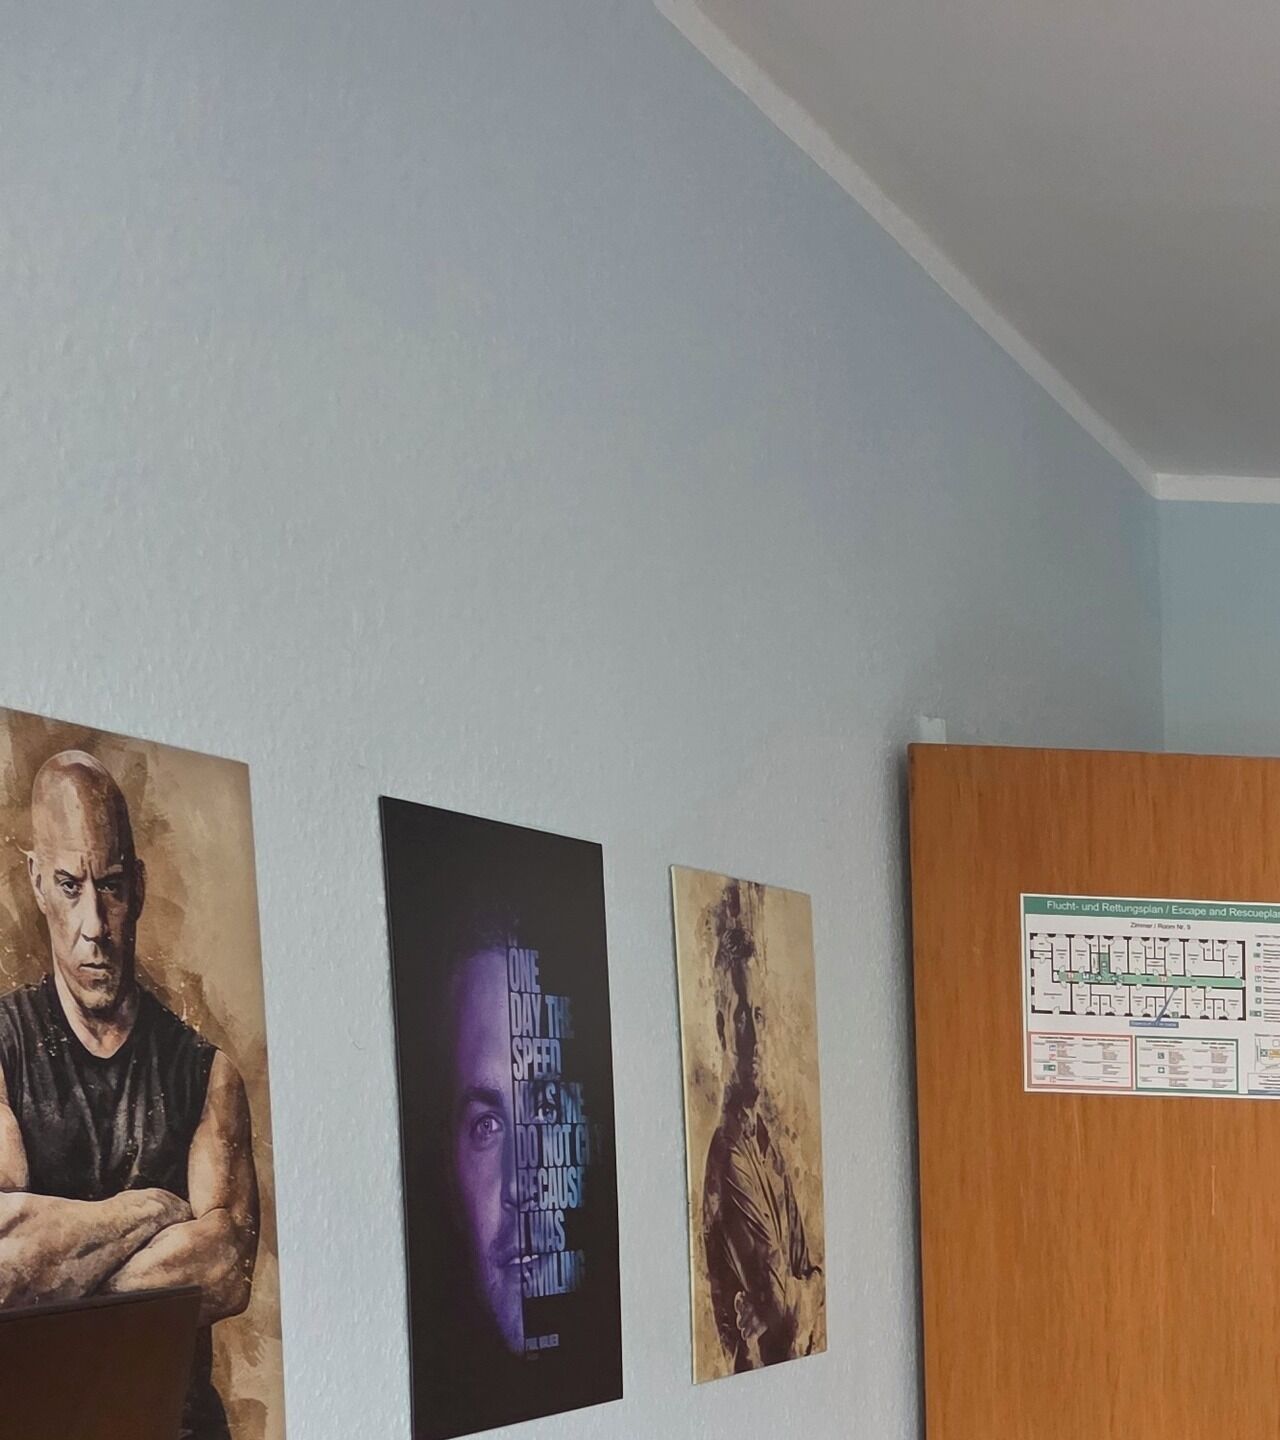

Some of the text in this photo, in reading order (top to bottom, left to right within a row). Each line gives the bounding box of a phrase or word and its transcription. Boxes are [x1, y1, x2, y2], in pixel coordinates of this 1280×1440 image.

[1046, 900, 1080, 910] Flucht-
[1081, 902, 1100, 912] und
[1102, 902, 1164, 915] Rettungsplan
[1171, 905, 1206, 916] Escape
[1208, 907, 1227, 917] and
[508, 947, 540, 993] ONE
[510, 992, 542, 1038] DAY
[512, 1037, 562, 1081] SPEED
[516, 1125, 538, 1168] DO
[542, 1124, 572, 1168] NOT
[529, 1210, 566, 1250] WAS
